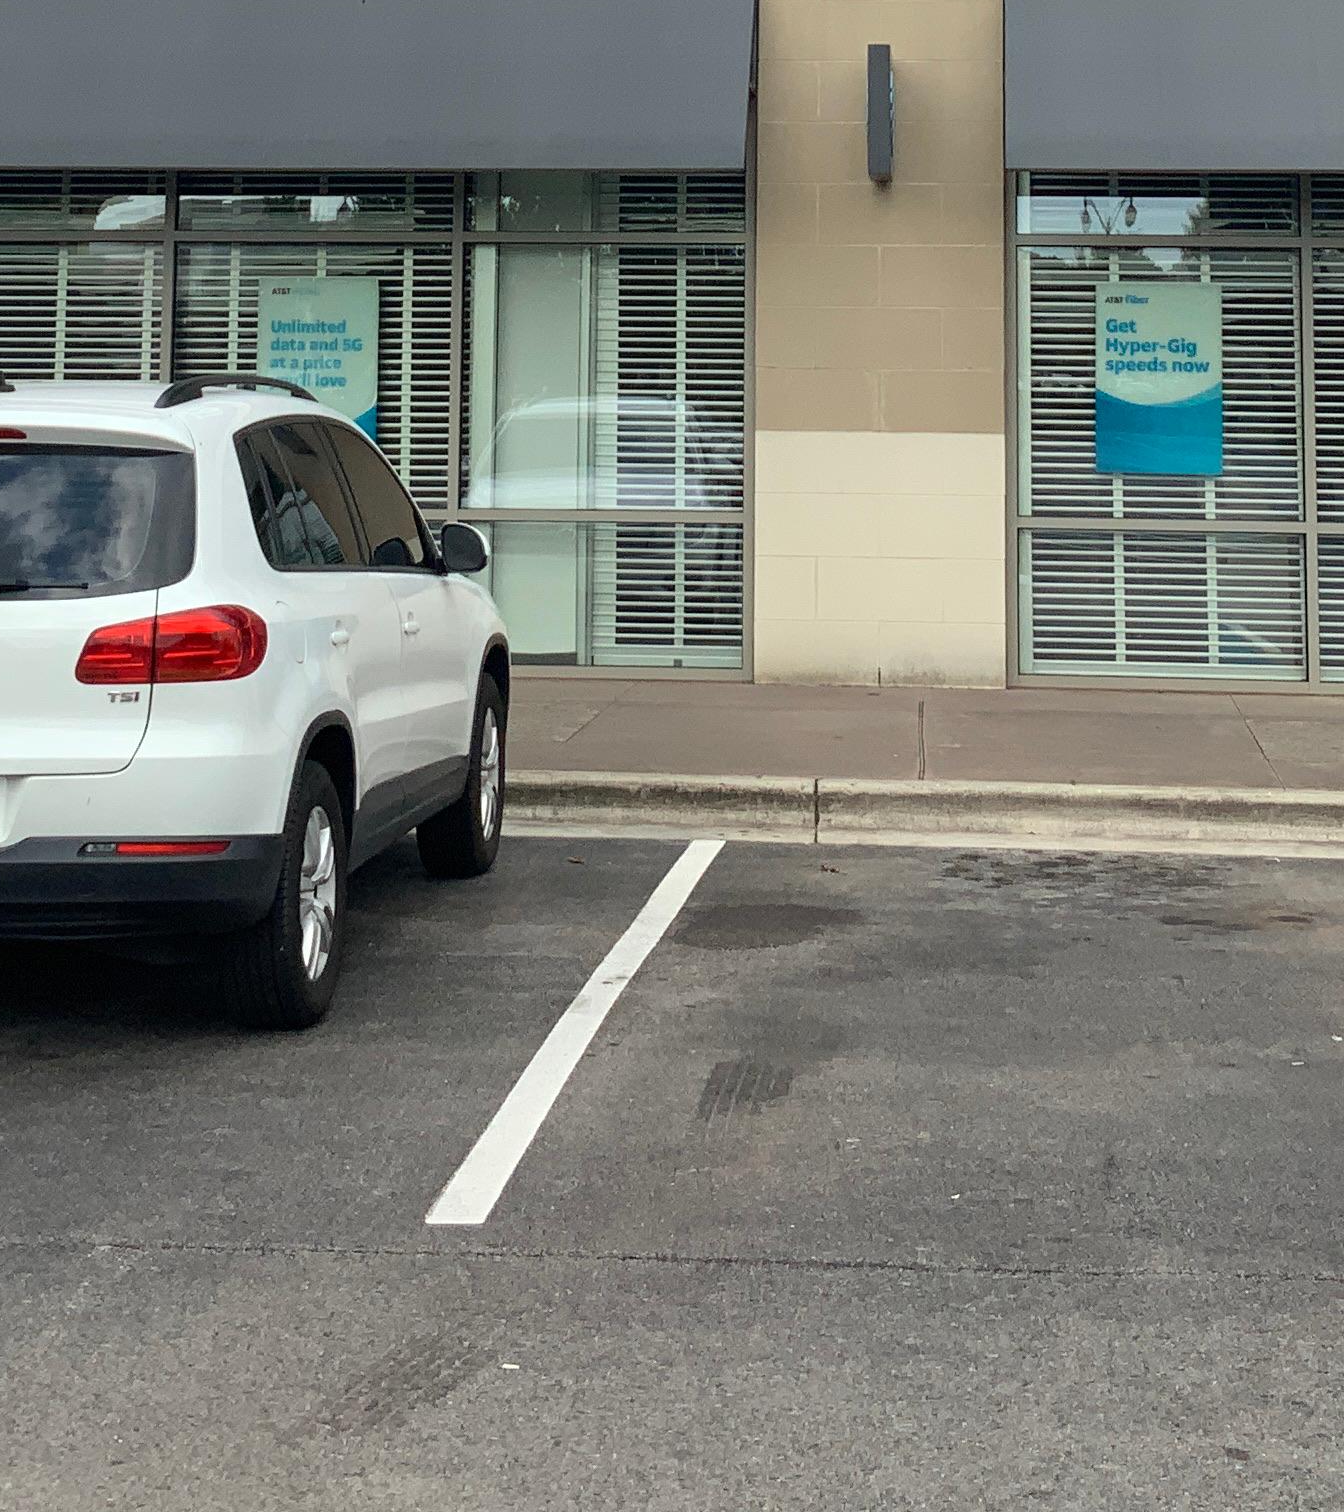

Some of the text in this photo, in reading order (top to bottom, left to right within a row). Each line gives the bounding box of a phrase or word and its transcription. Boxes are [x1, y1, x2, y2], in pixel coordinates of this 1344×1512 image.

[1104, 296, 1124, 304] AT&T
[270, 319, 347, 334] Unlimited
[1105, 318, 1138, 333] Get
[270, 338, 363, 352] data and 5G
[1105, 337, 1198, 357] Hyper-Gig
[269, 356, 342, 371] at a price
[1105, 356, 1210, 375] speeds now
[315, 373, 348, 387] love
[107, 691, 140, 704] TSI
